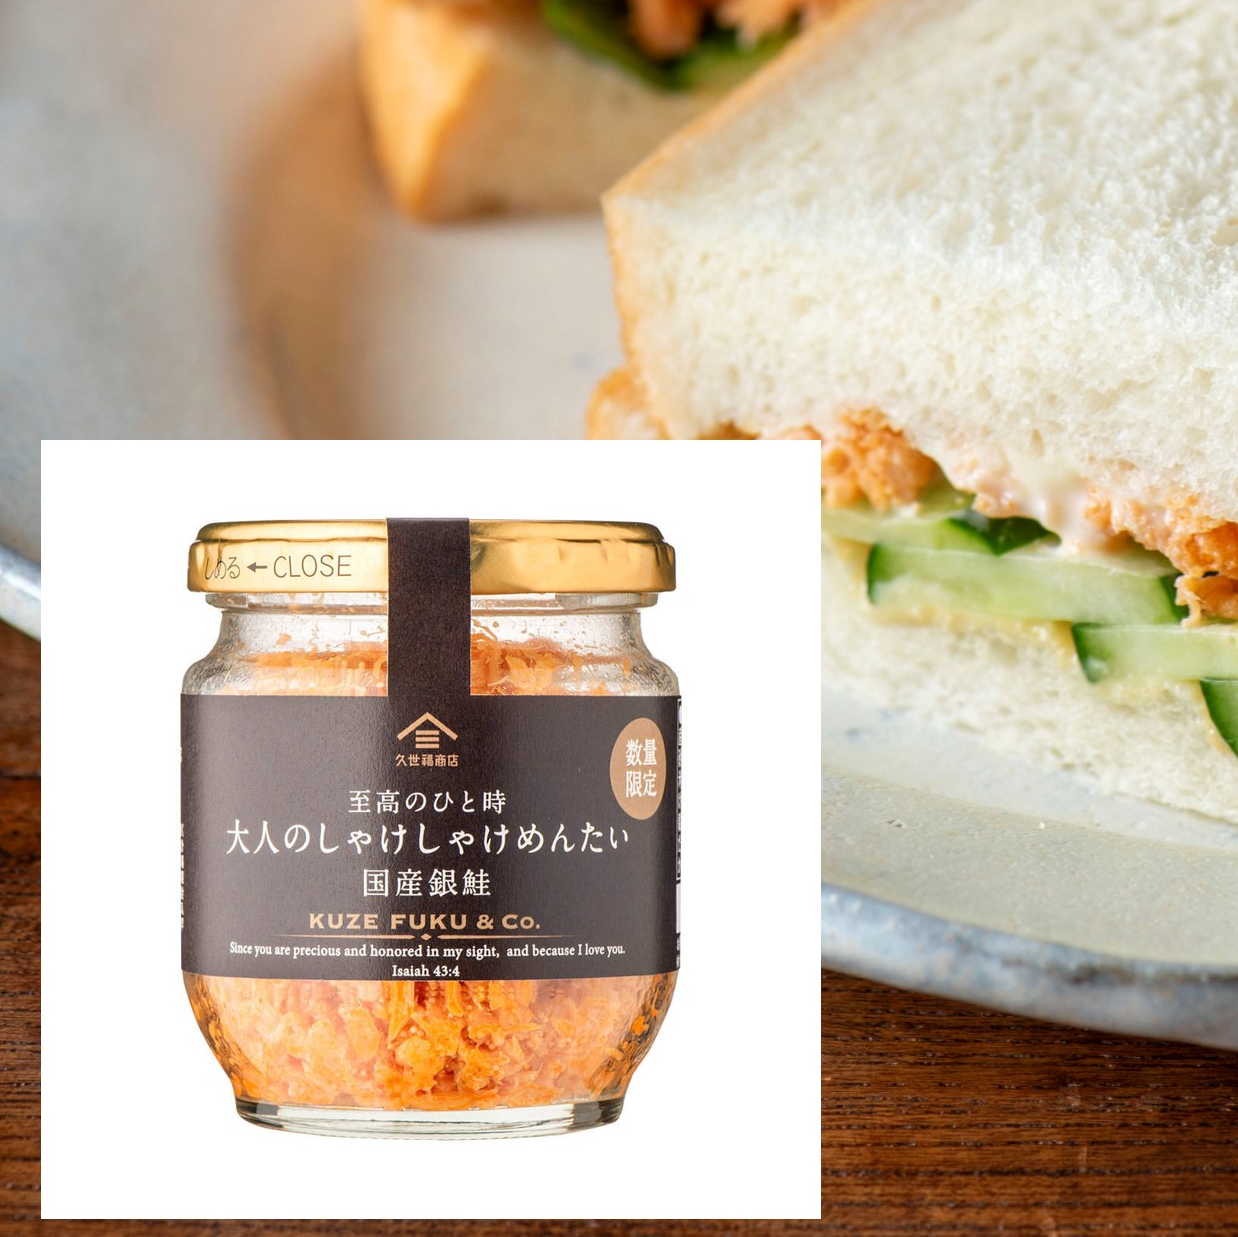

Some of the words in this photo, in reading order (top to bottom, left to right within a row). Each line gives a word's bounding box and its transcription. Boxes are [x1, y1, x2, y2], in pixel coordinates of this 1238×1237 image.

[273, 554, 352, 578] CLOSE
[395, 754, 459, 767] 久世福商店
[625, 738, 657, 766] 数量
[625, 770, 657, 798] 限定
[348, 789, 507, 814] 至高のひと時
[226, 819, 629, 856] 大人のしゃけしゃけめんたい
[362, 868, 491, 897] 国産銀鮭
[309, 913, 378, 929] KUZE
[390, 914, 467, 930] FUKU
[476, 914, 494, 930] &
[501, 914, 541, 930] Co.
[230, 941, 252, 955] Since
[254, 946, 272, 957] you
[274, 946, 290, 956] are
[293, 944, 341, 958] precious
[344, 944, 367, 956] and
[370, 944, 423, 957] honored
[426, 945, 440, 957] in
[442, 946, 463, 960] my
[466, 945, 500, 960] sight,
[507, 944, 530, 956] and
[532, 944, 575, 956] because
[578, 943, 583, 955] I
[585, 943, 605, 955] love
[607, 944, 626, 957] you.
[392, 965, 430, 976] Isaiah
[433, 965, 460, 976] 43:4
